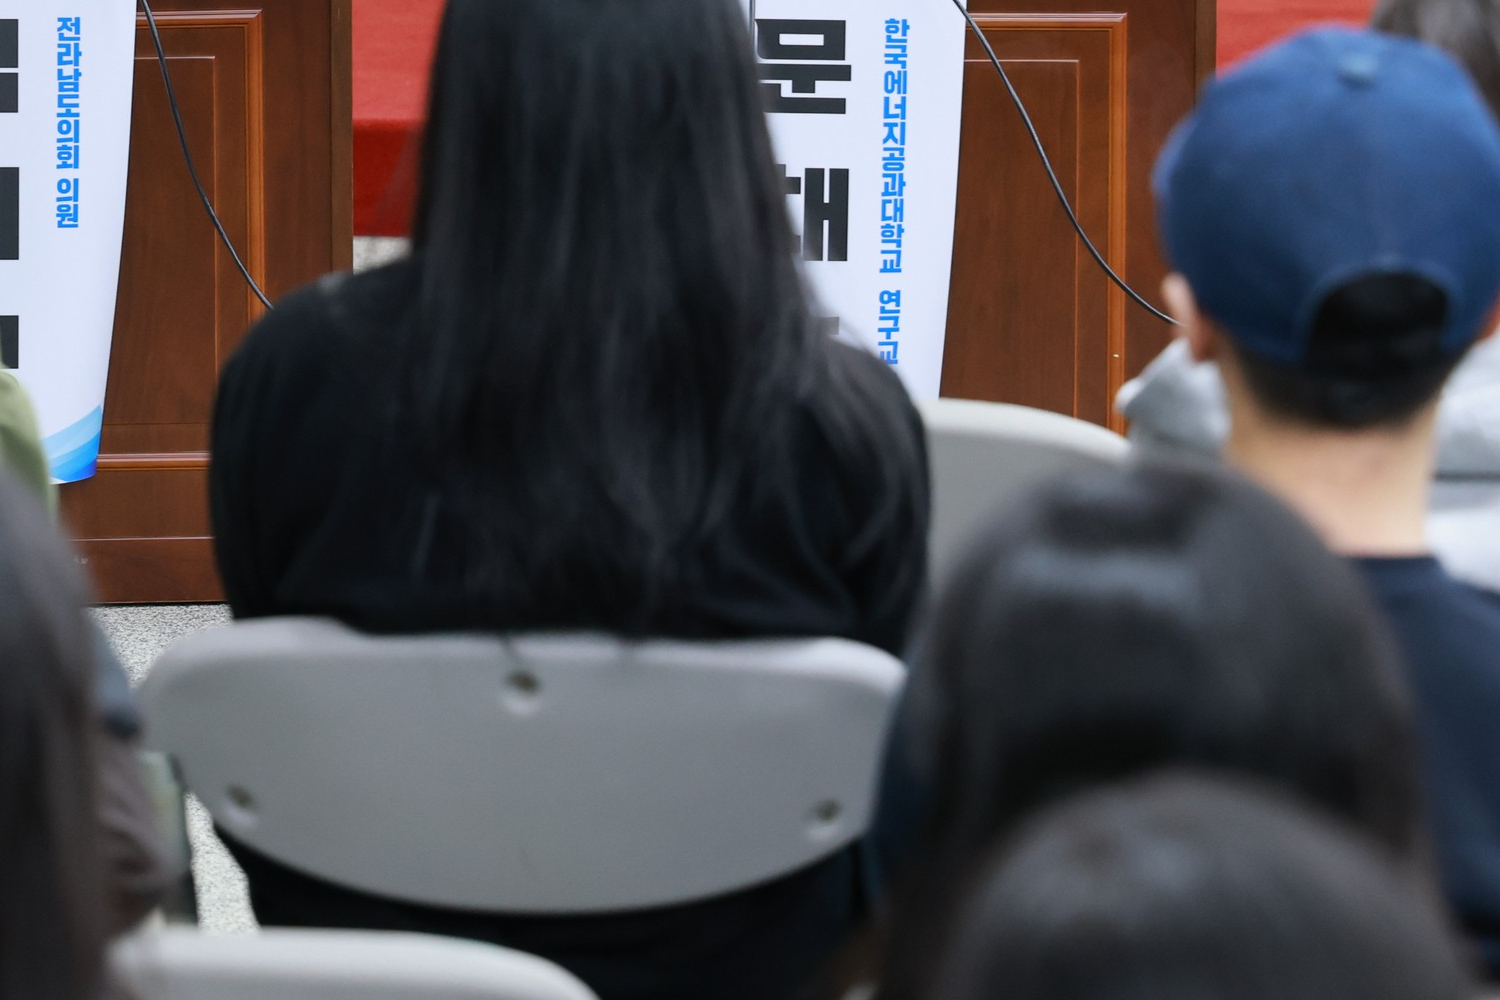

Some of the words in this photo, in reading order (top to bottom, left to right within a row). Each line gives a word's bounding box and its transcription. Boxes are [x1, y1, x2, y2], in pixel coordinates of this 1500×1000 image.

[56, 16, 83, 170] 전라남도의회
[879, 18, 911, 274] 한국에너지공과대학교
[56, 177, 80, 229] 의원
